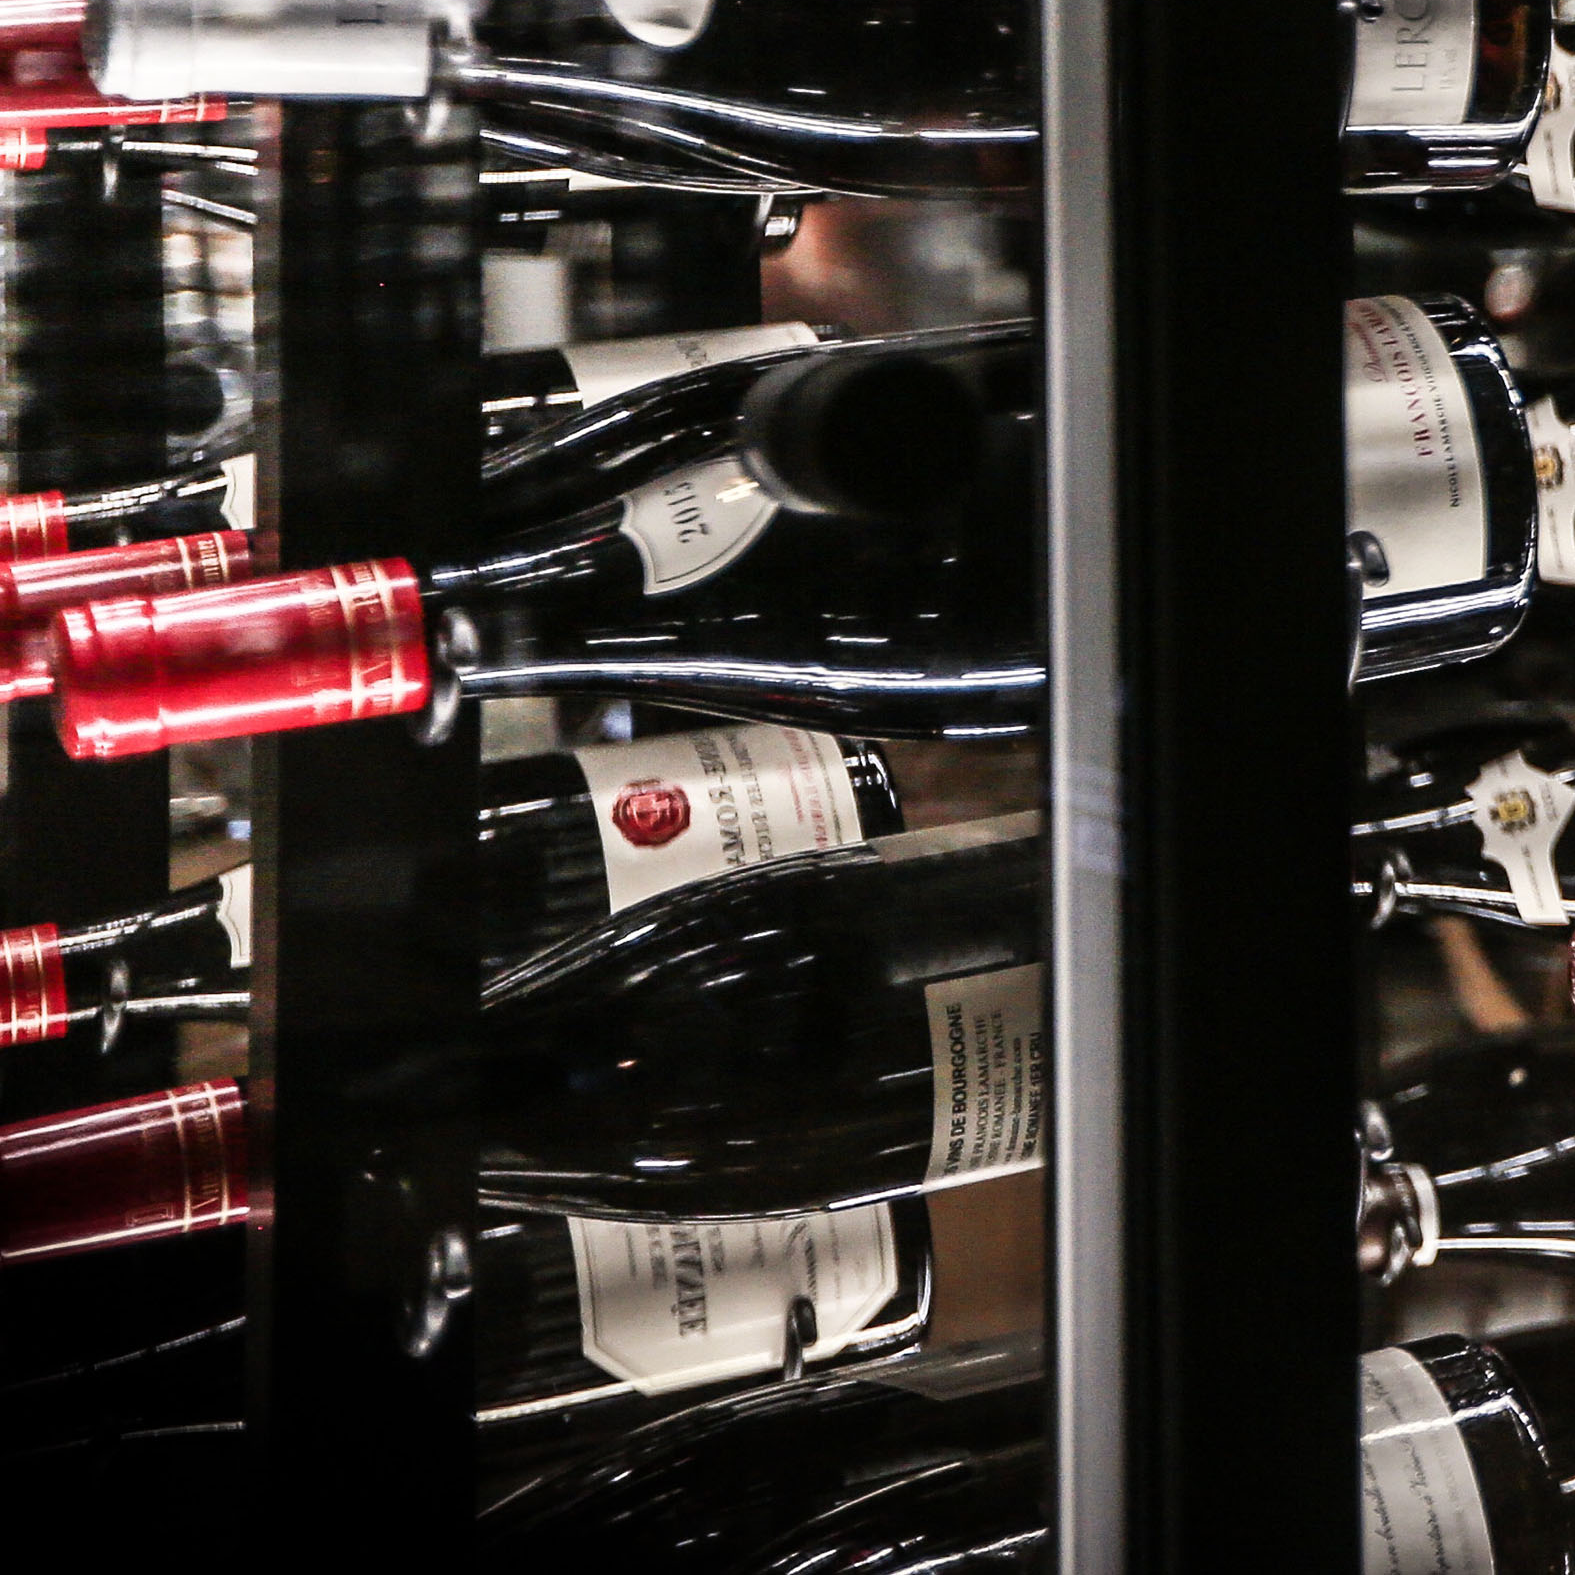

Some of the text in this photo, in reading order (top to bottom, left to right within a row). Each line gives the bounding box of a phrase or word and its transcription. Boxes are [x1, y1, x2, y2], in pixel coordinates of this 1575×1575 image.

[1390, 350, 1433, 457] FRANÇOIS
[664, 481, 709, 543] 2015
[1448, 463, 1461, 508] NICOLE
[945, 1003, 967, 1114] BOURGOGNE
[974, 1017, 989, 1097] LAMARCHE
[990, 1011, 1004, 1068] FRANCE
[1029, 1032, 1045, 1059] CRU
[1030, 1063, 1044, 1086] 1ER
[950, 1118, 966, 1136] DE
